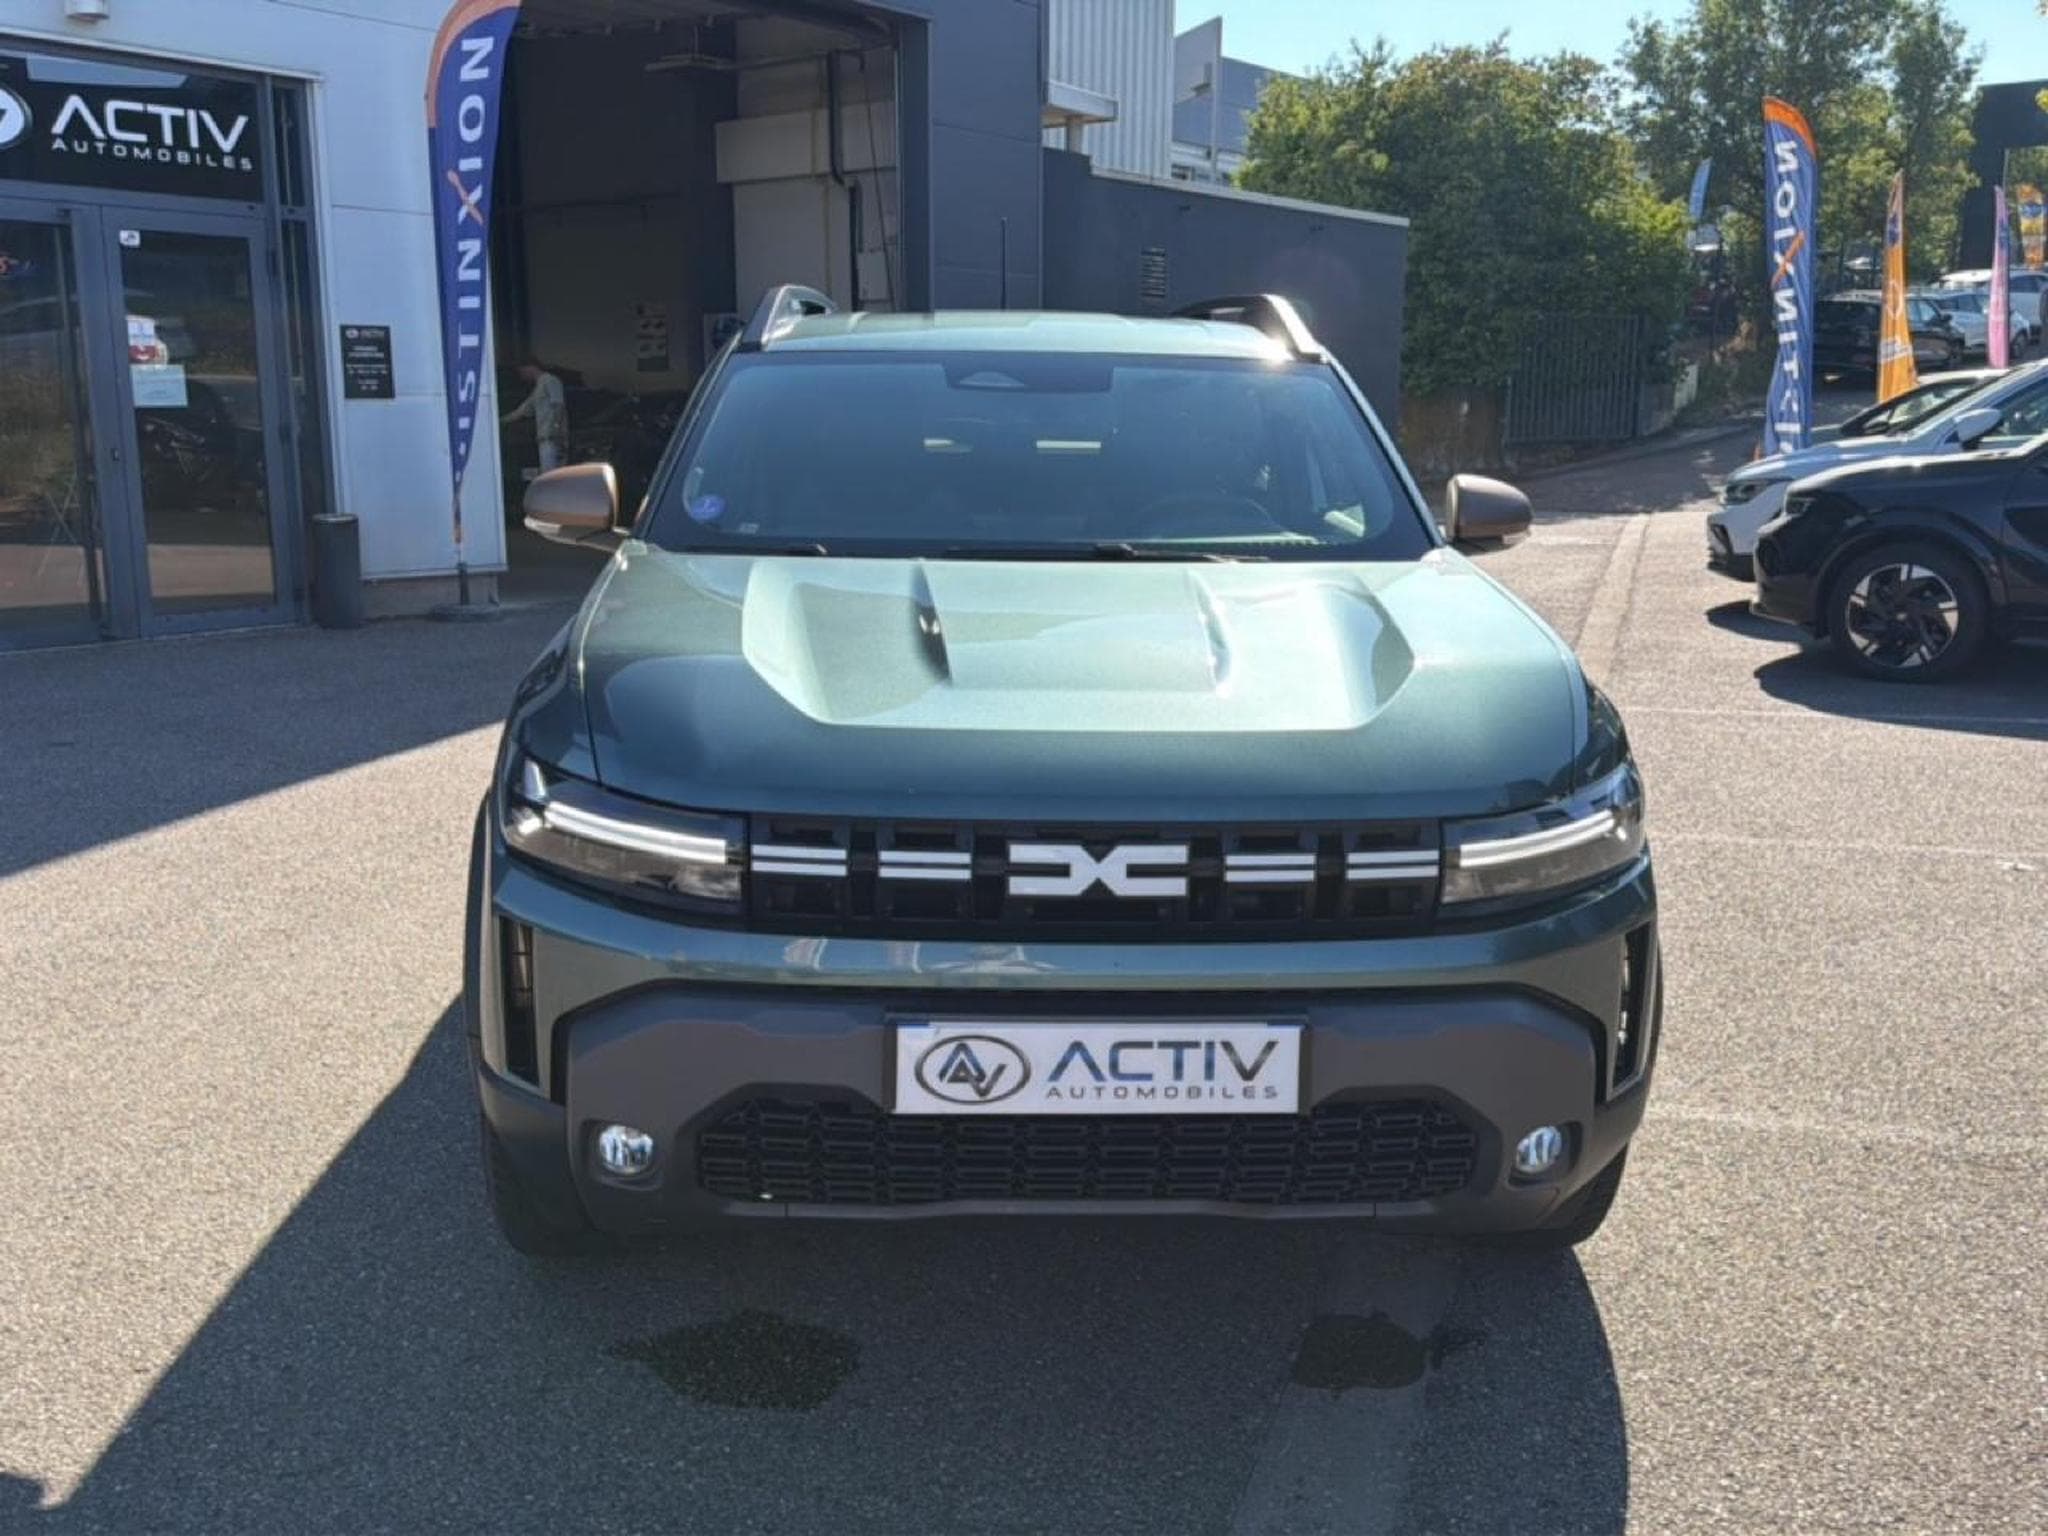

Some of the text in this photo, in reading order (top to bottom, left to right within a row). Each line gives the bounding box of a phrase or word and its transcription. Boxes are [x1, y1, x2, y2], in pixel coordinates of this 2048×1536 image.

[51, 94, 249, 153] ACTIV
[51, 137, 253, 171] AUTOMOBILES
[1047, 1040, 1279, 1082] ACTIV
[1046, 1085, 1279, 1100] AUTOMOBILES
